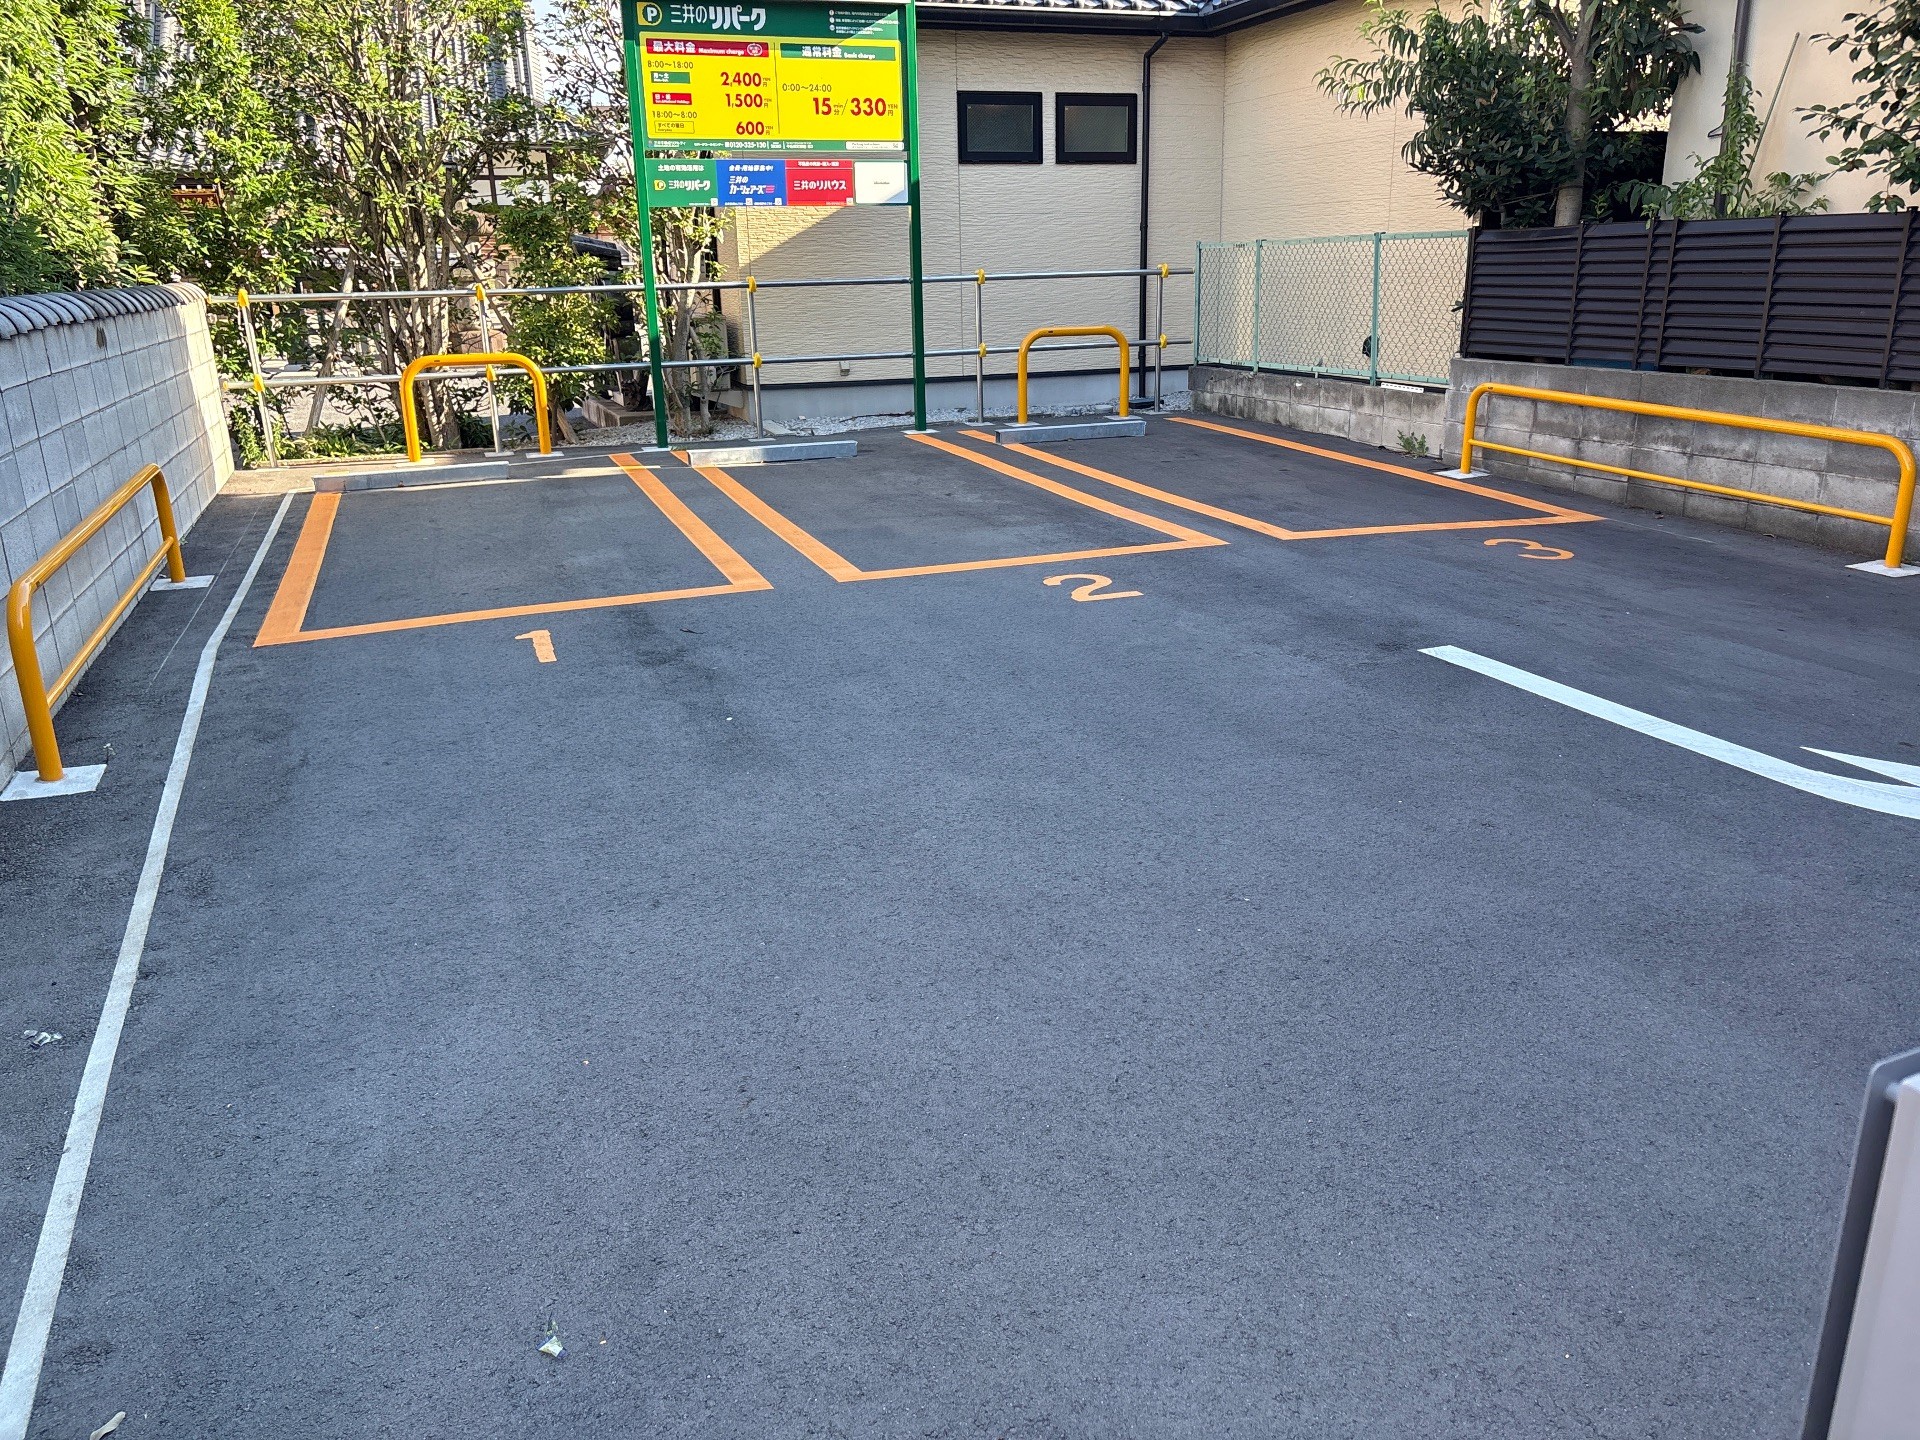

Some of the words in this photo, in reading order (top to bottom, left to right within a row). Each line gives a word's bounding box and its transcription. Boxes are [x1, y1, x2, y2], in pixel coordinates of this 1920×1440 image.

[670, 3, 767, 31] 三井のリパーク
[653, 40, 696, 53] 最大料金
[726, 48, 745, 57] charge
[720, 71, 762, 88] 2,400
[725, 93, 763, 108] 1,500
[812, 97, 832, 116] 15
[850, 97, 887, 117] 330
[887, 109, 894, 117] 円
[736, 121, 765, 136] 600
[668, 179, 711, 191] 三井のリパーク
[728, 175, 749, 184] 三井の
[793, 179, 847, 191] 三井のリハウス
[1483, 538, 1575, 560] 3
[1042, 573, 1144, 602] 2
[515, 629, 557, 663] 1
